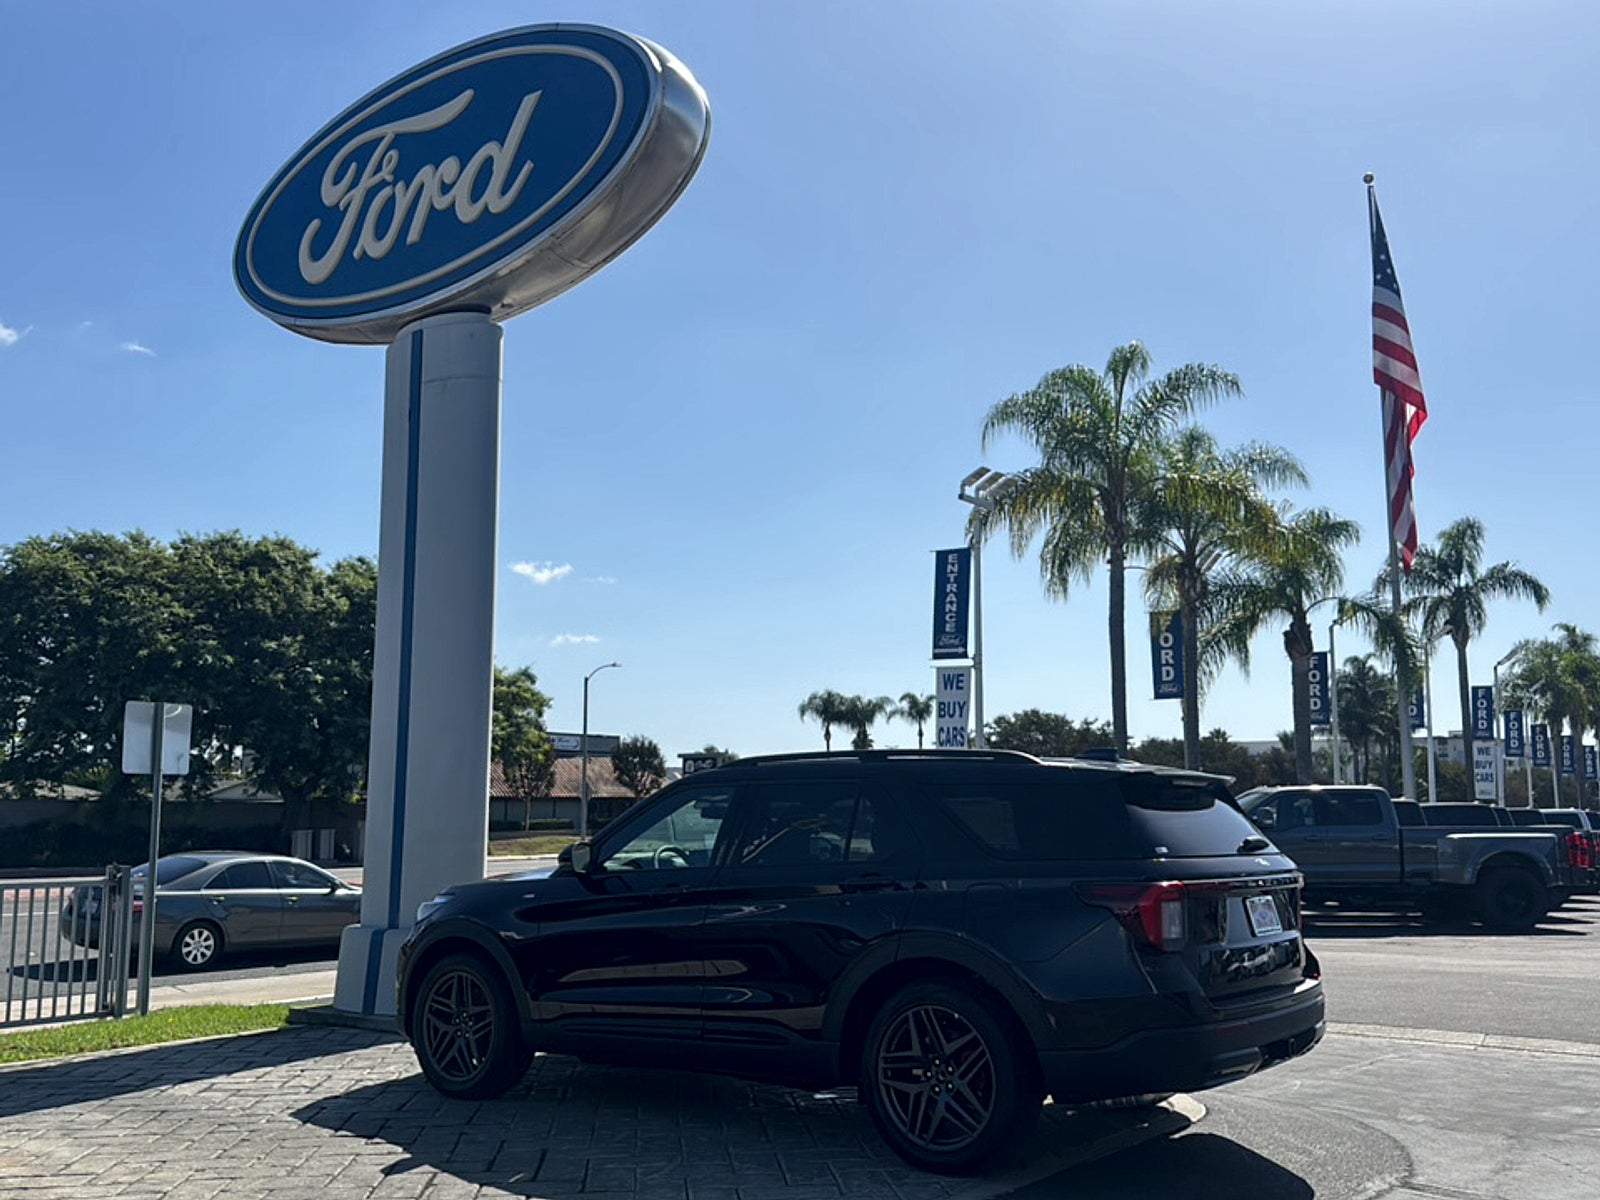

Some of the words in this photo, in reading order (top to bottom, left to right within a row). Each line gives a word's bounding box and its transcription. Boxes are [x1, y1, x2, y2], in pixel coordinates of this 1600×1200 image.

[299, 88, 543, 284] Ford
[944, 552, 959, 633] ENTRANCE
[943, 673, 965, 691] WE
[1307, 656, 1322, 711] FORD
[938, 701, 967, 718] BUY
[1476, 688, 1488, 730] FORD
[938, 726, 965, 748] CARS
[1508, 711, 1519, 749] FORD
[1476, 746, 1492, 757] WE
[1474, 760, 1493, 770] BUY
[1474, 772, 1495, 784] CARS
